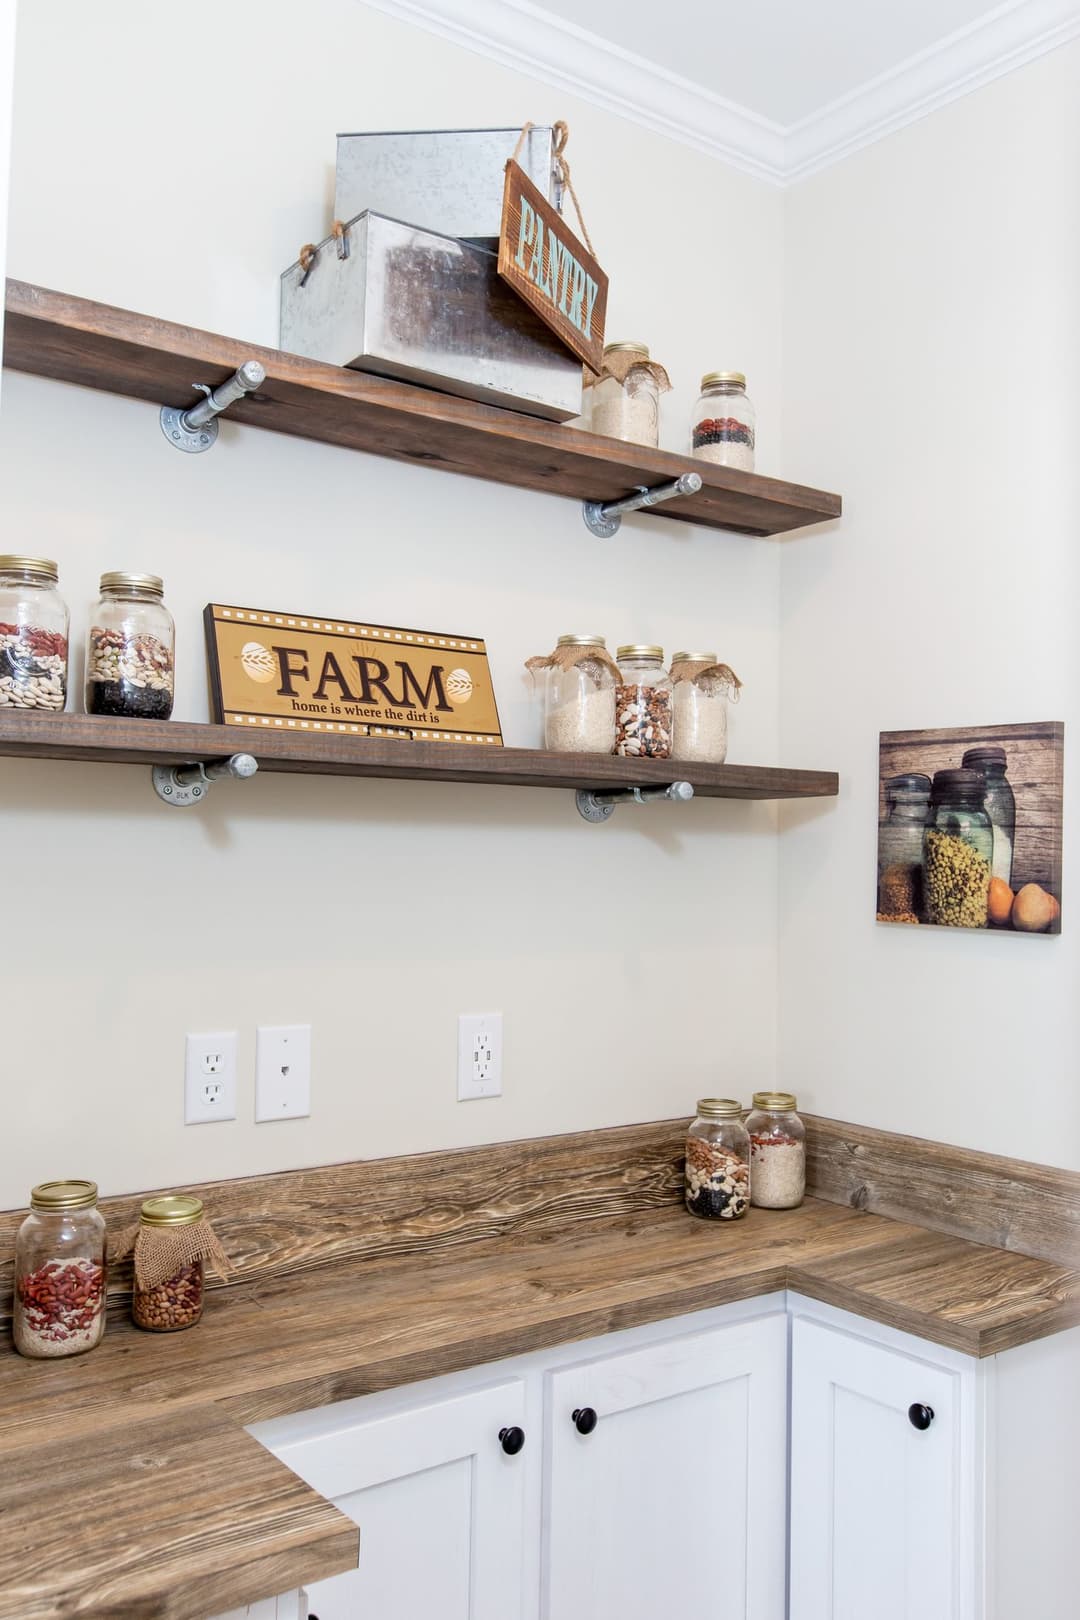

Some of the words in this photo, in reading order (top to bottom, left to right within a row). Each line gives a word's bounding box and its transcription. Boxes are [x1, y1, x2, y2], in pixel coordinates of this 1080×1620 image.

[514, 195, 599, 342] PANTRY
[271, 646, 454, 712] FARM
[291, 699, 328, 713] home
[330, 703, 342, 715] is
[344, 705, 382, 718] where
[384, 708, 404, 720] the
[406, 710, 428, 723] dirt
[429, 712, 440, 724] is
